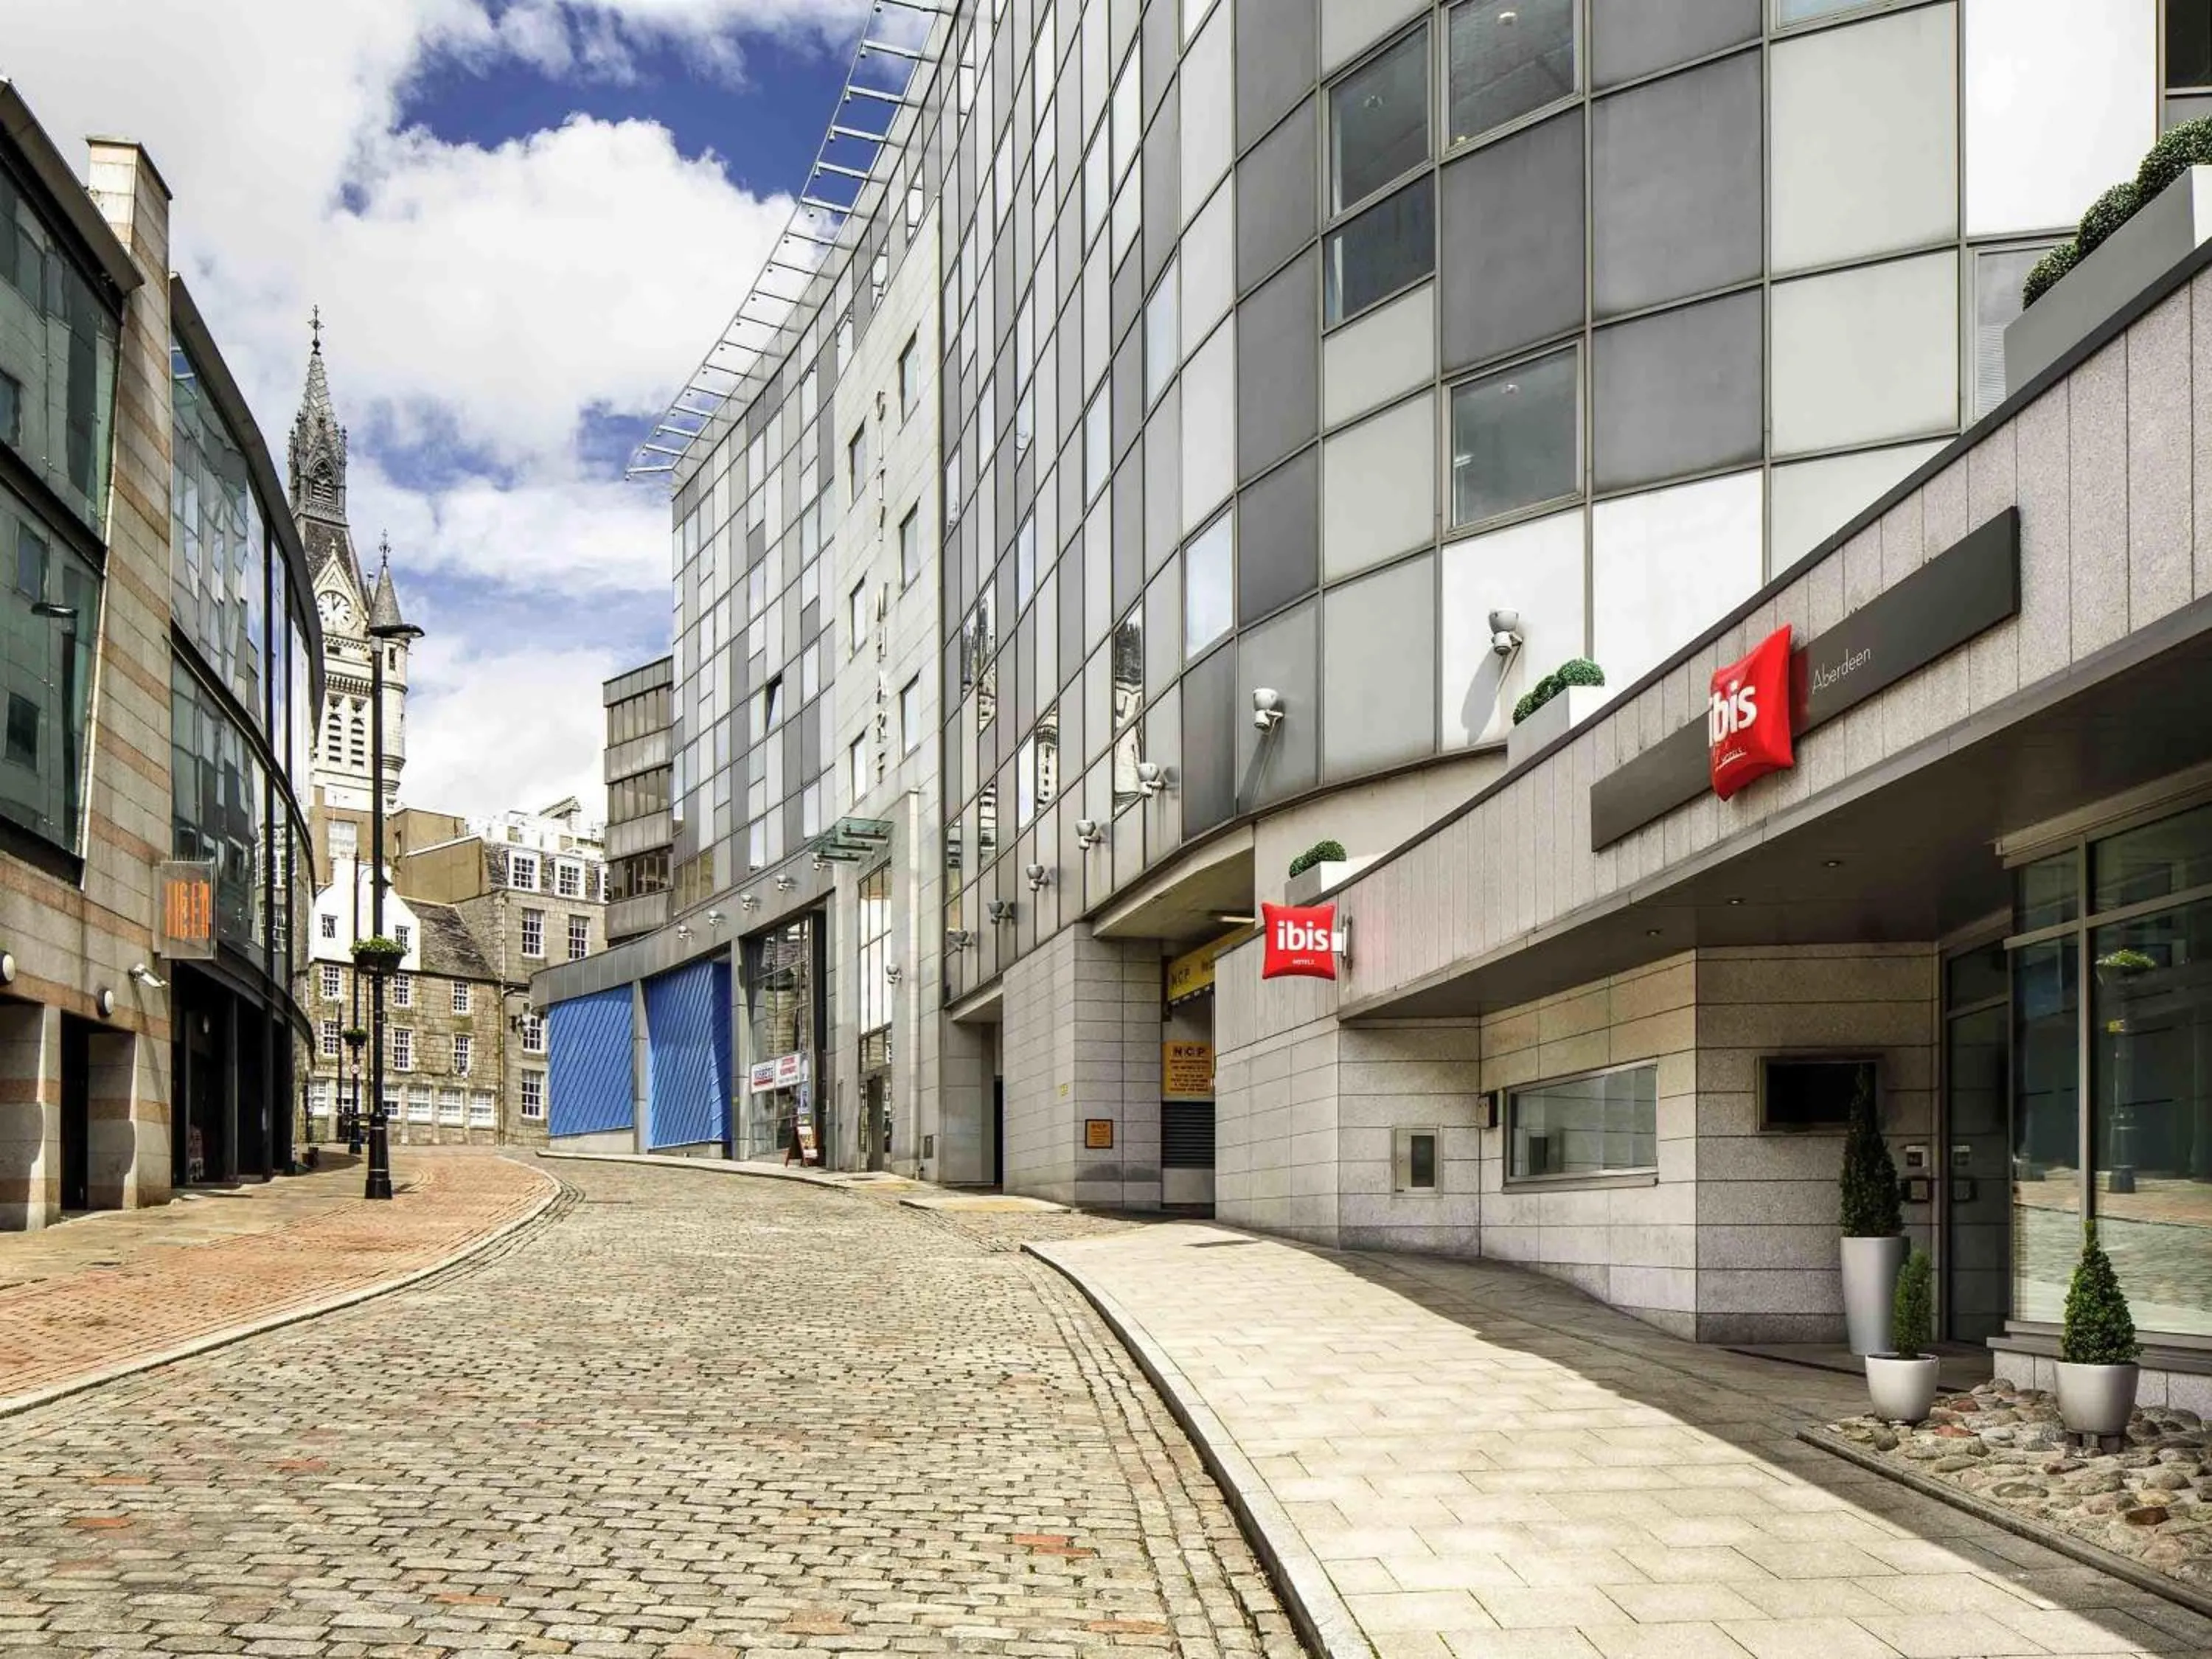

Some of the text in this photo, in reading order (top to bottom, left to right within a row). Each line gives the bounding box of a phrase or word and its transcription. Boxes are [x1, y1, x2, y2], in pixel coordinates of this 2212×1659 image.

[875, 582, 889, 785] WHARF
[1812, 647, 1871, 695] Aberdeen
[1708, 679, 1758, 748] ibis
[1277, 920, 1329, 952] ibis
[1172, 967, 1190, 987] NCP
[1175, 1047, 1205, 1057] NCP
